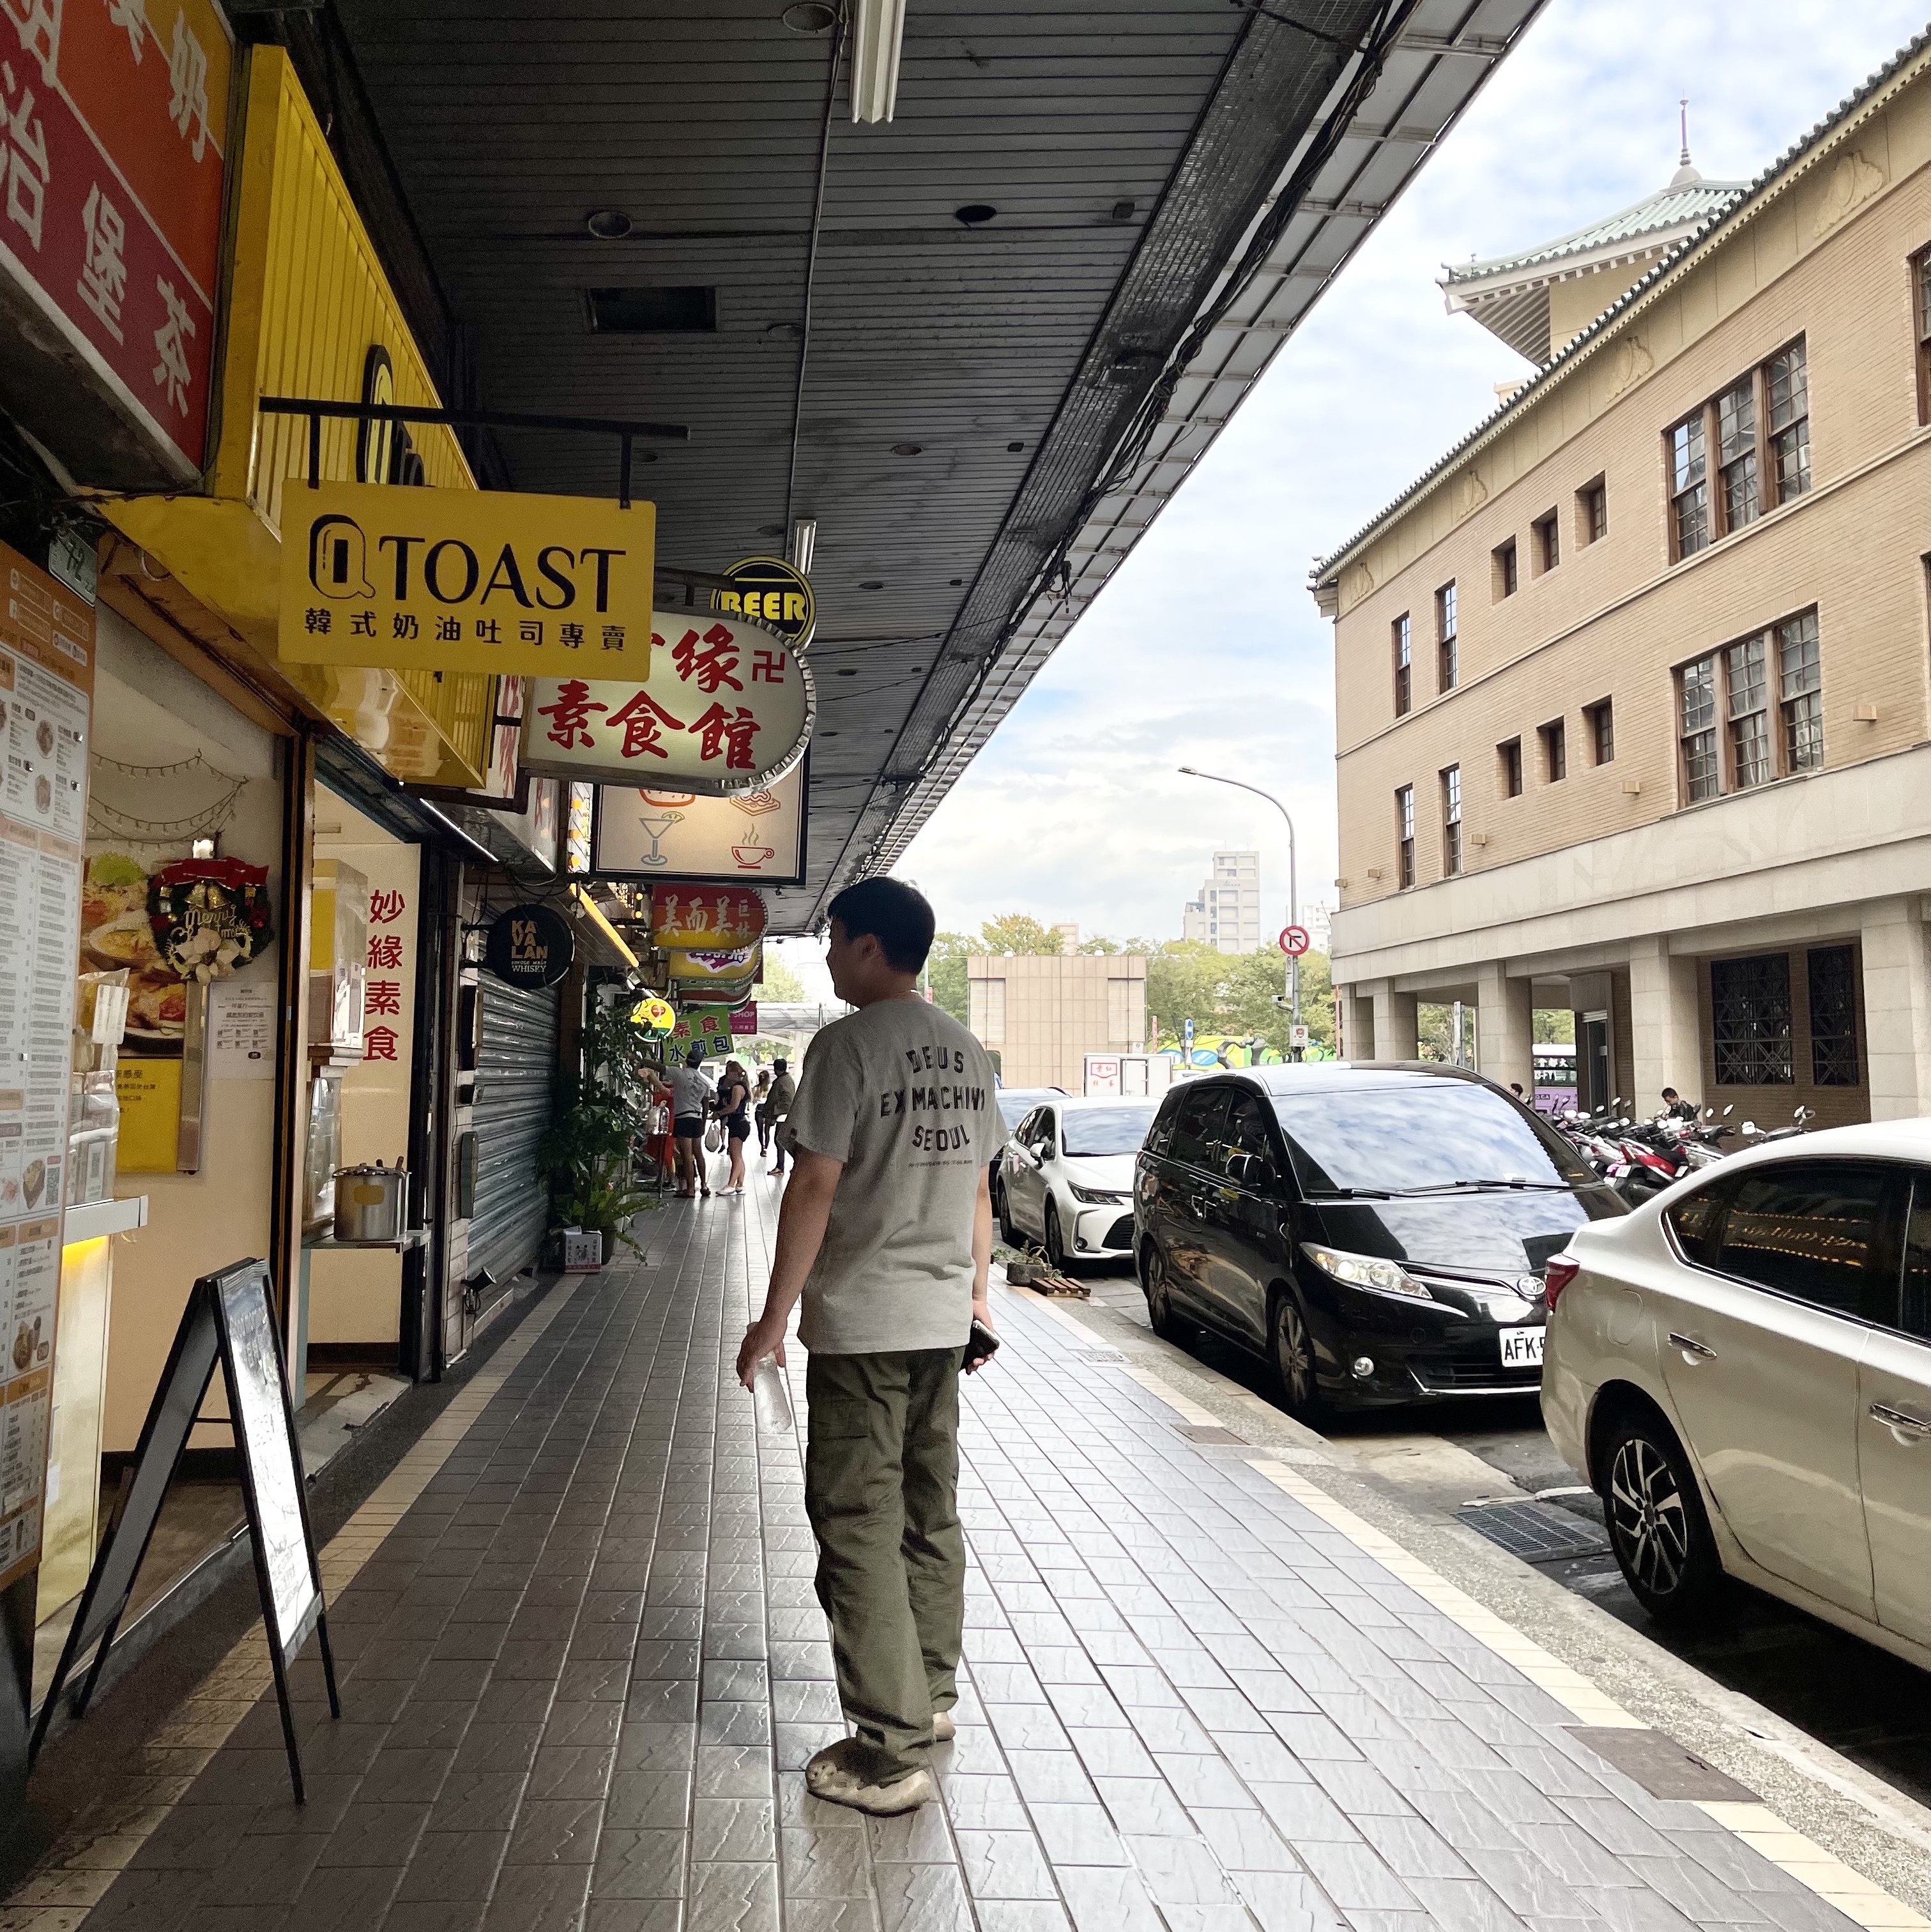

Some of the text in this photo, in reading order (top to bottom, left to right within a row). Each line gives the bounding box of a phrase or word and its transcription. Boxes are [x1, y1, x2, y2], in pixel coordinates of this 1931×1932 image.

[721, 591, 806, 620] BEER
[303, 607, 626, 651] 韓式奶油吐司專賣
[537, 680, 761, 770] 素食館
[184, 904, 238, 929] Merry
[659, 894, 733, 938] 美而美
[512, 945, 548, 959] LAN
[362, 889, 405, 1061] 妙緣素食
[673, 1015, 720, 1039] 素食
[906, 1046, 964, 1074] DEUS
[880, 1088, 906, 1118] EX
[912, 1124, 970, 1152] SEOUL
